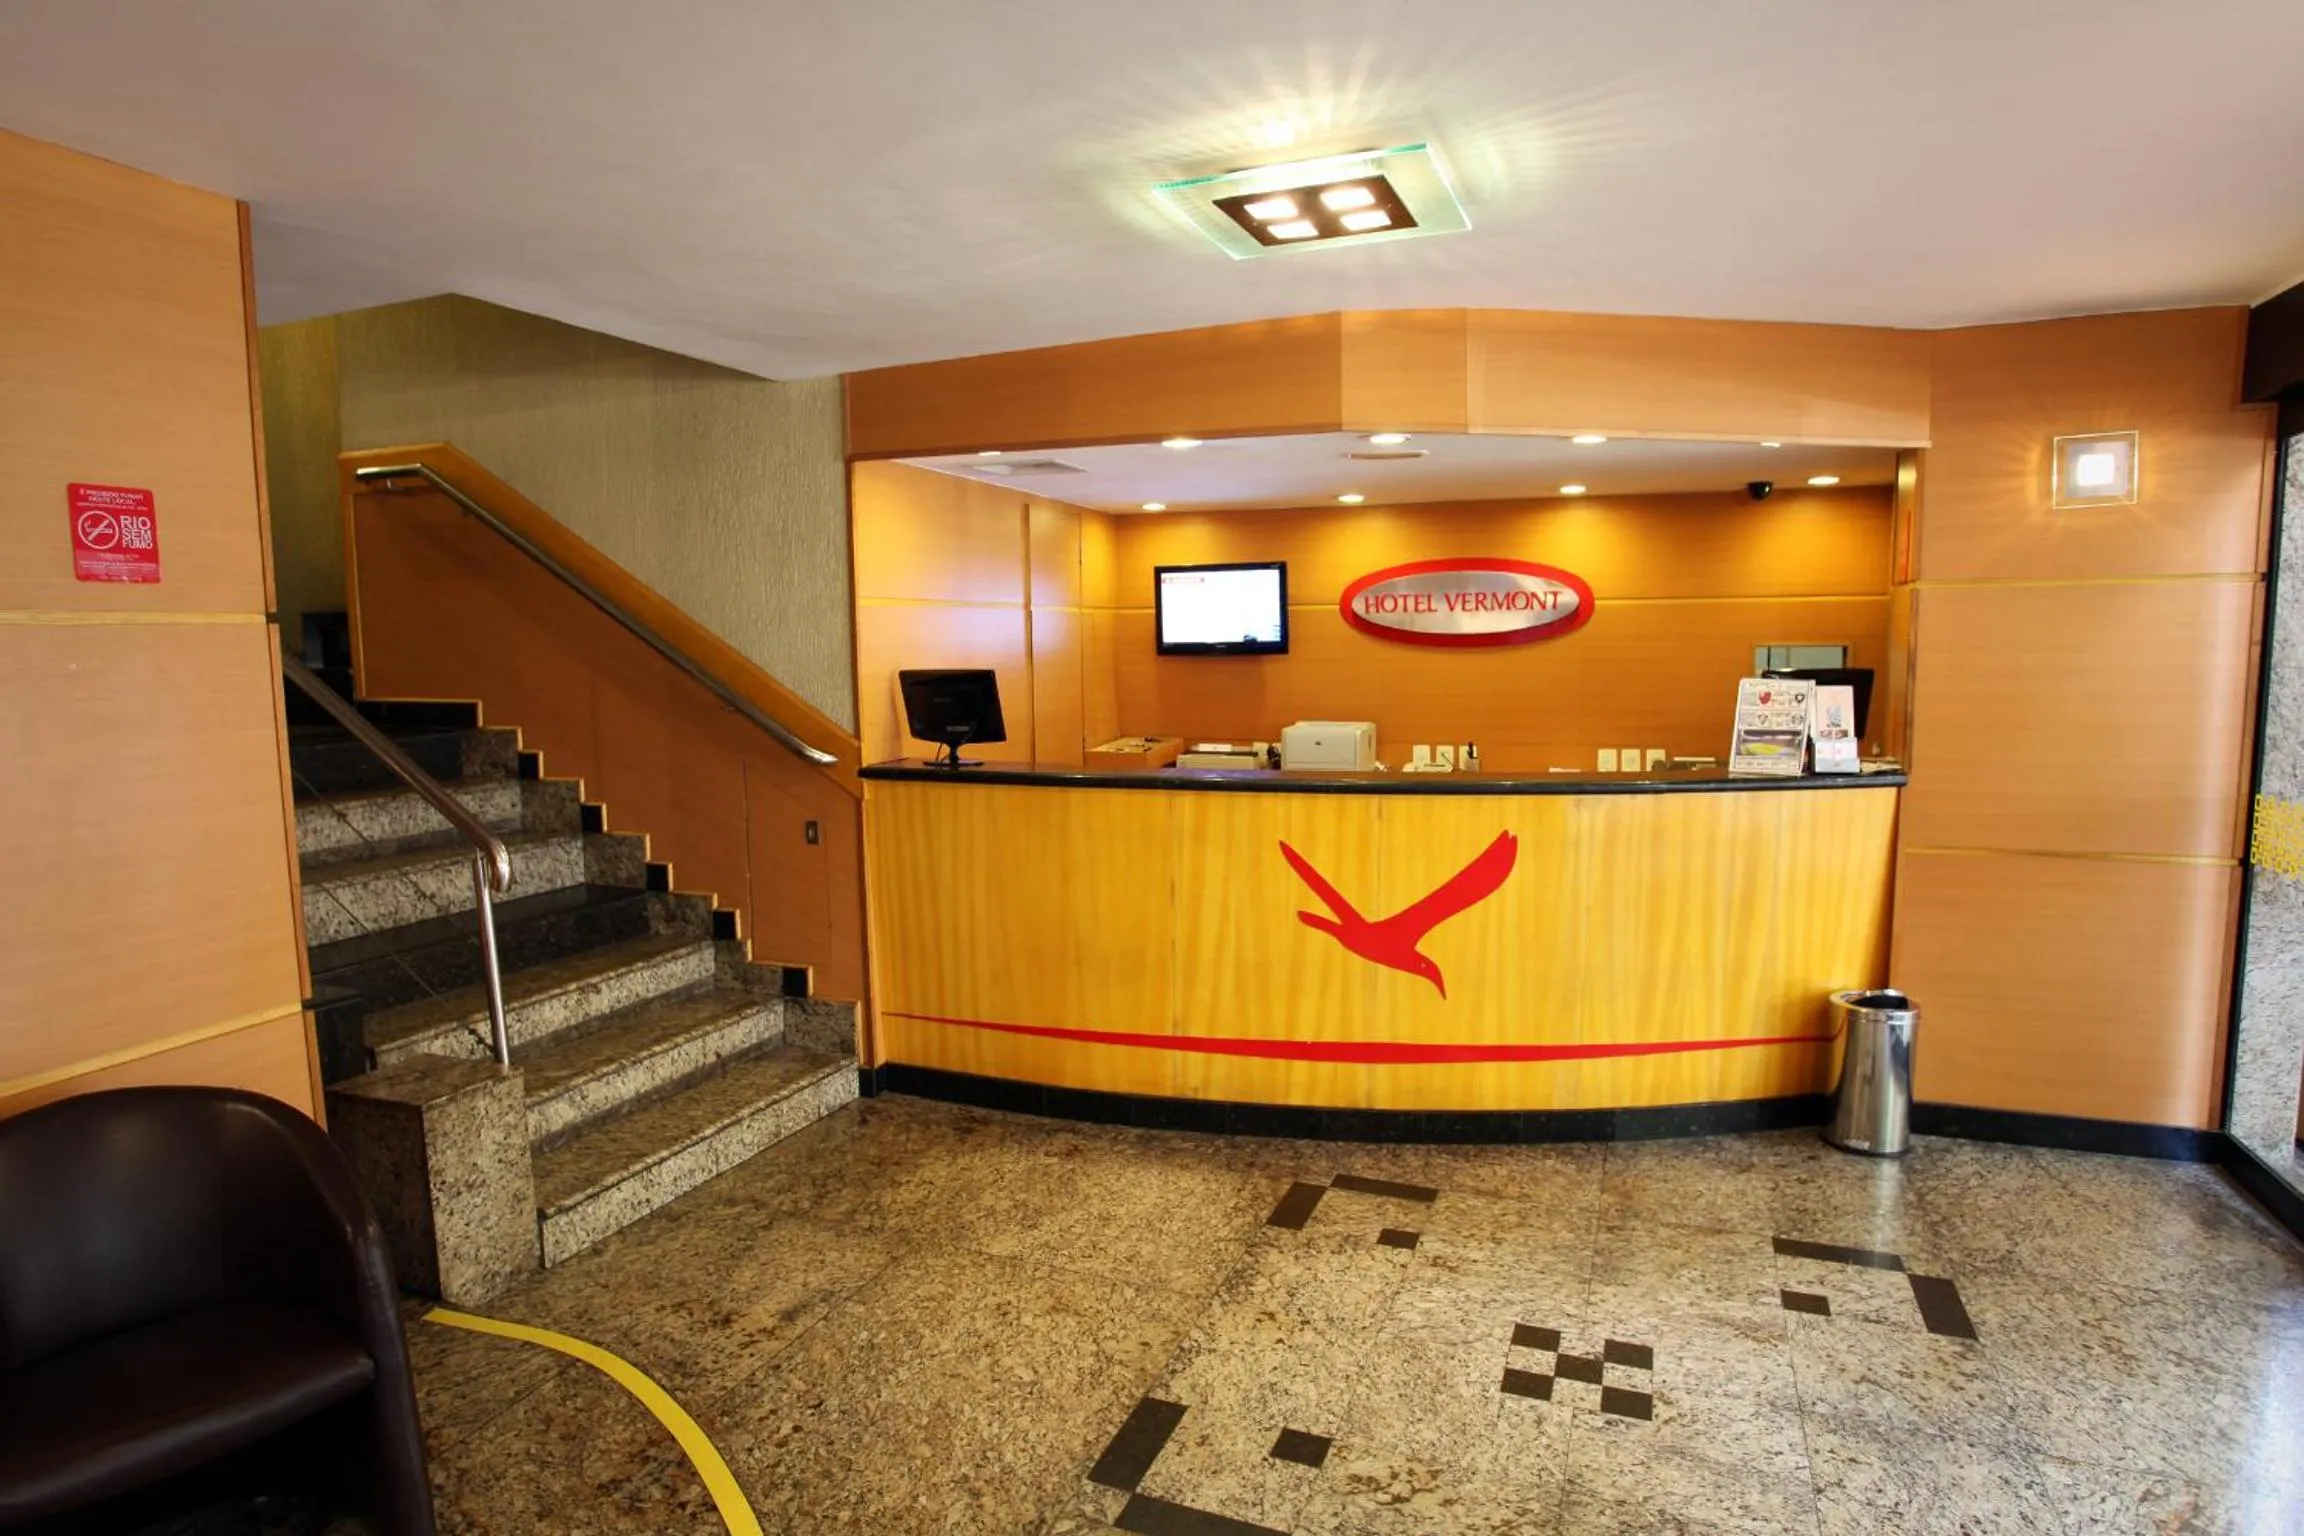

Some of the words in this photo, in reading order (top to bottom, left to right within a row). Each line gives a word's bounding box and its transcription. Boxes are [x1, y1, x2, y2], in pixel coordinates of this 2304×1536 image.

[120, 515, 151, 530] RIO
[122, 528, 152, 541] SEM
[1364, 592, 1438, 614] HOTEL
[1444, 590, 1562, 611] VERMONT
